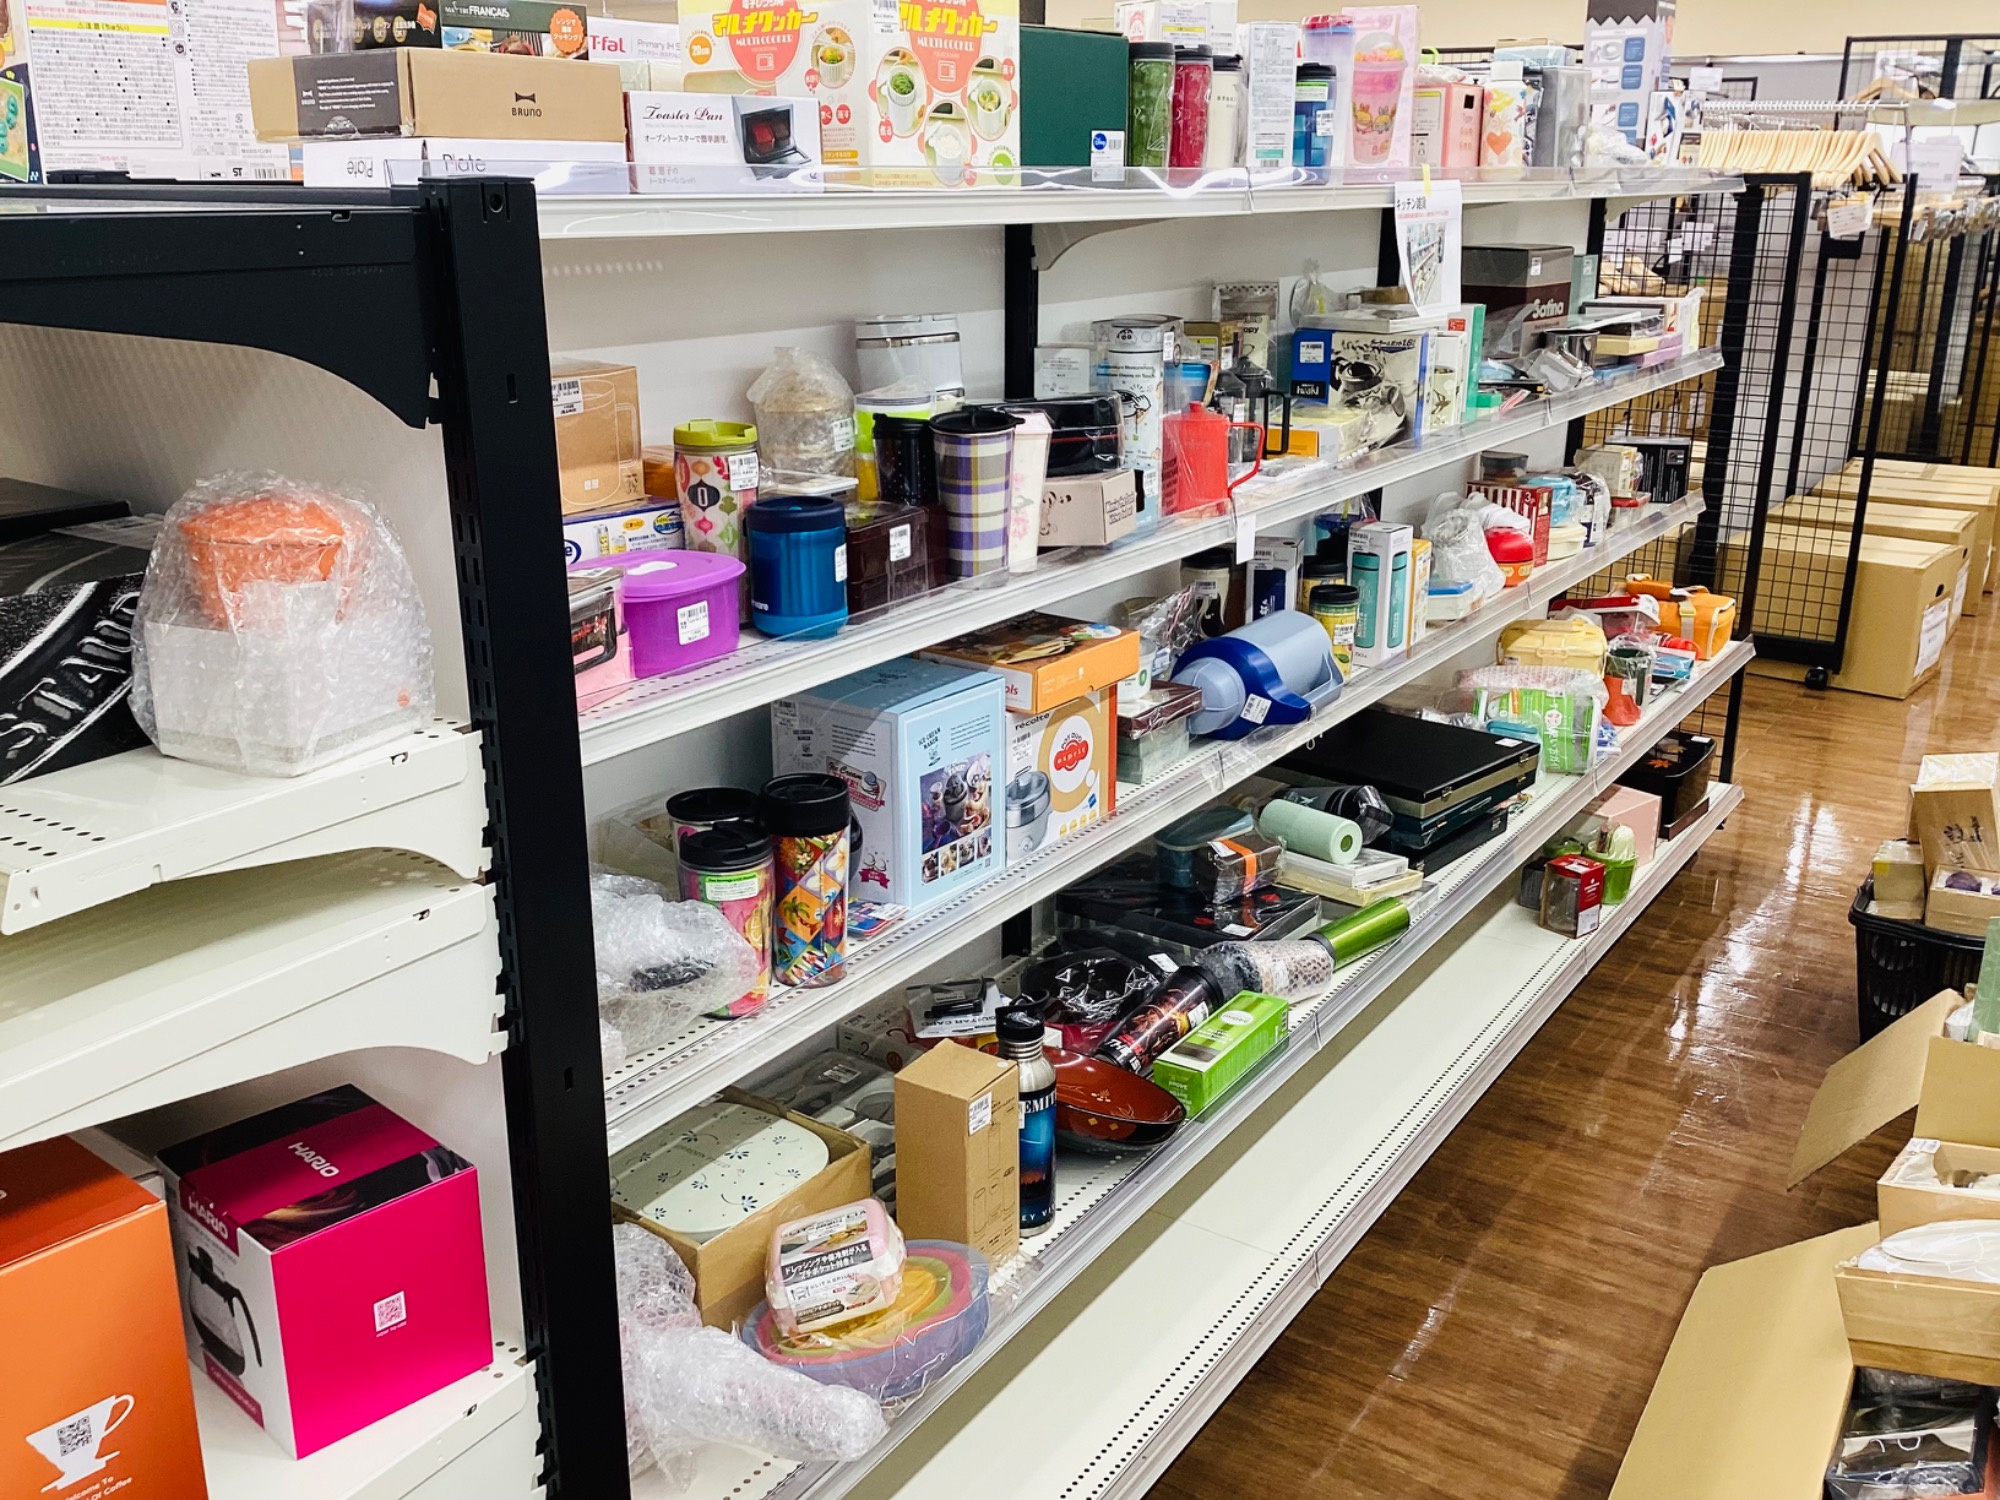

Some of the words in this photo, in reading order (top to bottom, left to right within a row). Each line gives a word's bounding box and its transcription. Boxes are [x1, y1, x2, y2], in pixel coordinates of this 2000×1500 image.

[712, 8, 819, 38] マルチクッカー
[511, 107, 543, 117] BRUNO
[642, 103, 690, 121] Toaster
[693, 106, 724, 121] Pan
[442, 154, 487, 172] Plate
[1015, 712, 1050, 731] récolte
[288, 1141, 340, 1178] HARIO
[188, 1195, 229, 1240] HARIO
[101, 1476, 114, 1485] To
[103, 1477, 133, 1495] Coffee
